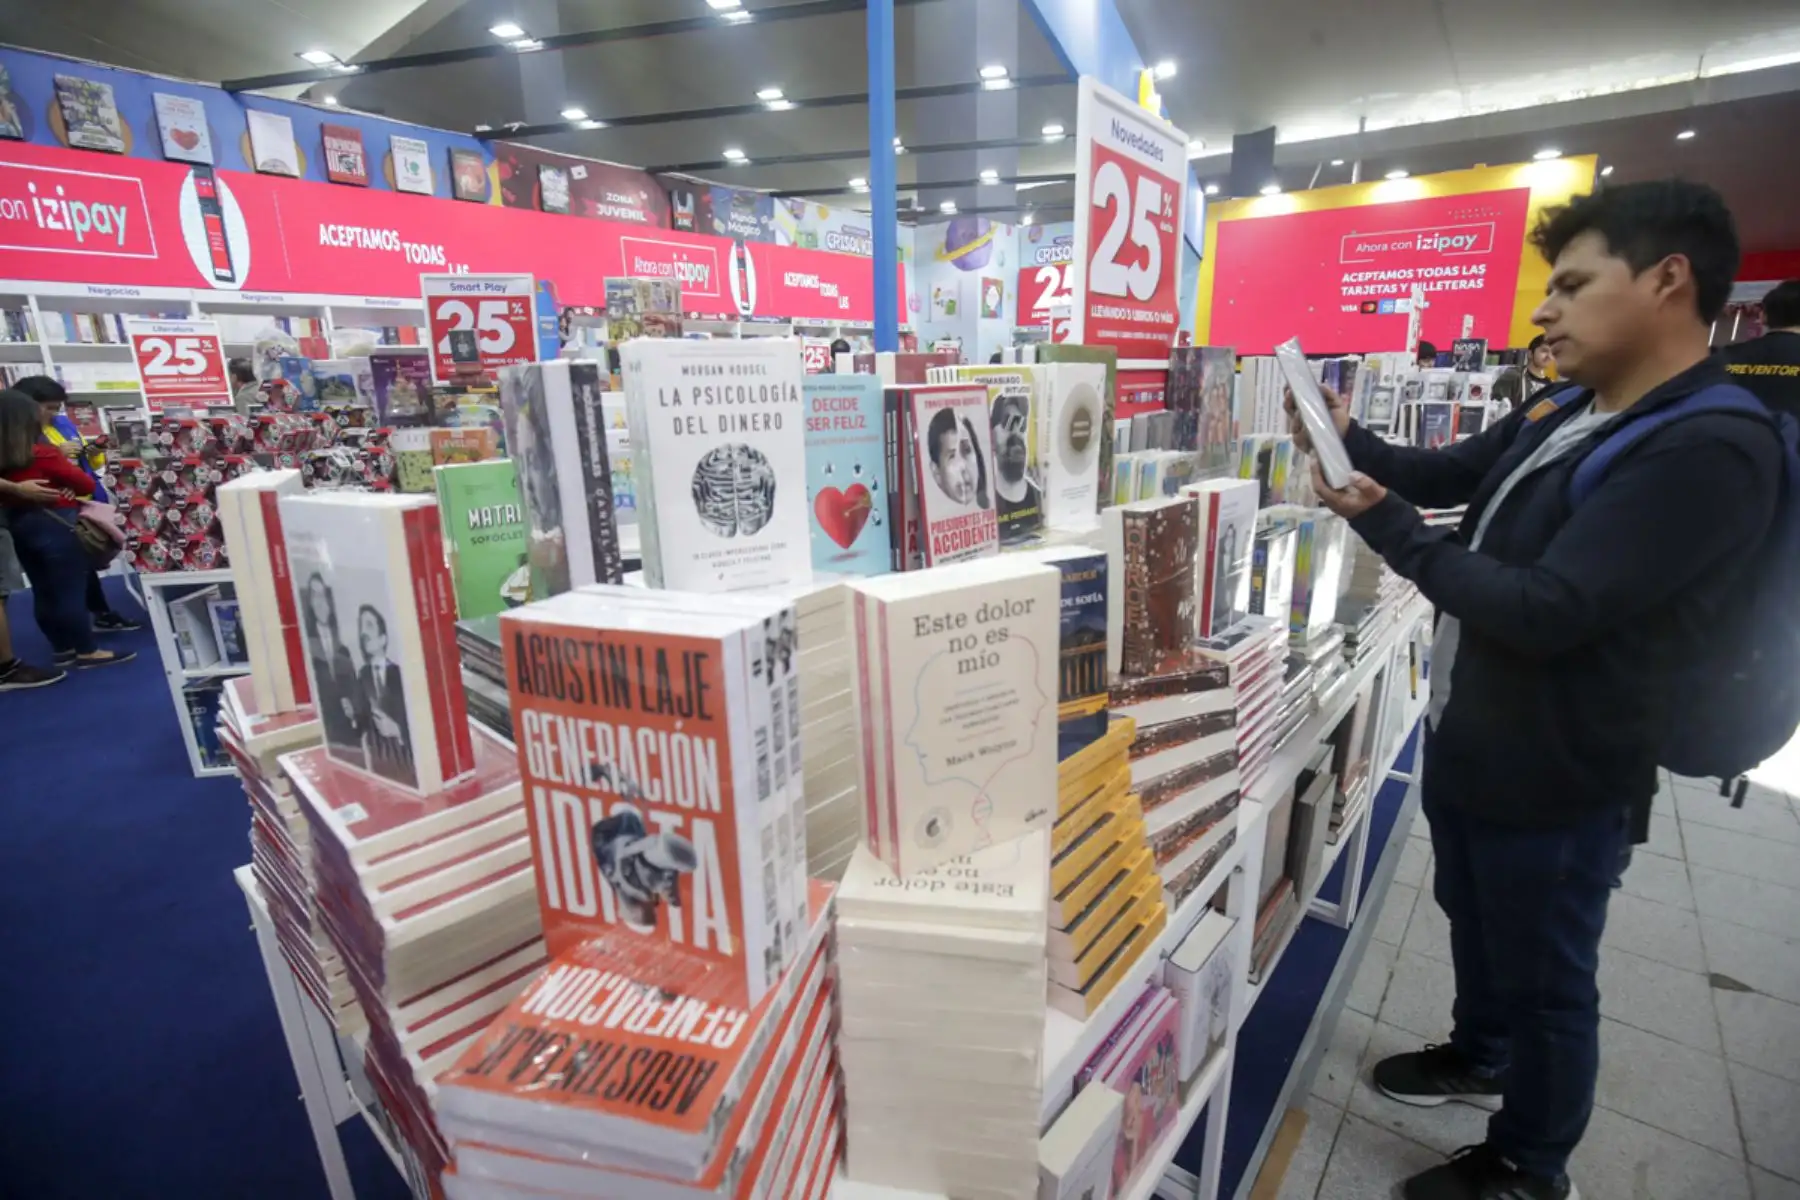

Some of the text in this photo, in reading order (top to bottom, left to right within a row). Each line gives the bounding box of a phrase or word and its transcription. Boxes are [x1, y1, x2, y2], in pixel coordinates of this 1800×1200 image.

[1111, 116, 1164, 163] Novedades
[605, 192, 634, 205] ZONA
[28, 181, 126, 246] izipay
[596, 204, 648, 222] JUVENIL
[1090, 160, 1162, 301] 25
[1355, 232, 1478, 253] Ahora con izipay
[319, 224, 401, 251] ACEPTAMOS
[402, 241, 446, 266] TODAS
[1036, 246, 1073, 262] CRISO
[672, 252, 711, 291] izipay
[1341, 263, 1486, 283] ACEPTAMOS TODAS LAS
[87, 285, 141, 297] Negocios
[449, 281, 507, 294] Smart Play
[1341, 282, 1398, 297] TARJETAS
[1399, 283, 1408, 293] Y
[436, 299, 516, 355] 25
[140, 336, 208, 377] 25
[805, 347, 826, 369] 25
[1454, 342, 1480, 351] NASA
[681, 364, 724, 377] MORGAN
[658, 381, 799, 408] LA PSICOLOGÍA
[812, 396, 859, 413] DECIDE
[673, 412, 784, 436] DEL DINERO
[806, 414, 867, 432] SER FELIZ
[930, 511, 980, 536] PRESIDENTES
[933, 521, 997, 557] ACCIDENTE
[913, 610, 967, 639] Este
[975, 597, 1036, 626] dolor
[948, 626, 1010, 655] no es
[514, 627, 714, 722] AGUSTÍN LAJE
[956, 650, 1001, 676] mío
[521, 708, 723, 814] GENERACIÓN
[873, 876, 1015, 898] Este dolor
